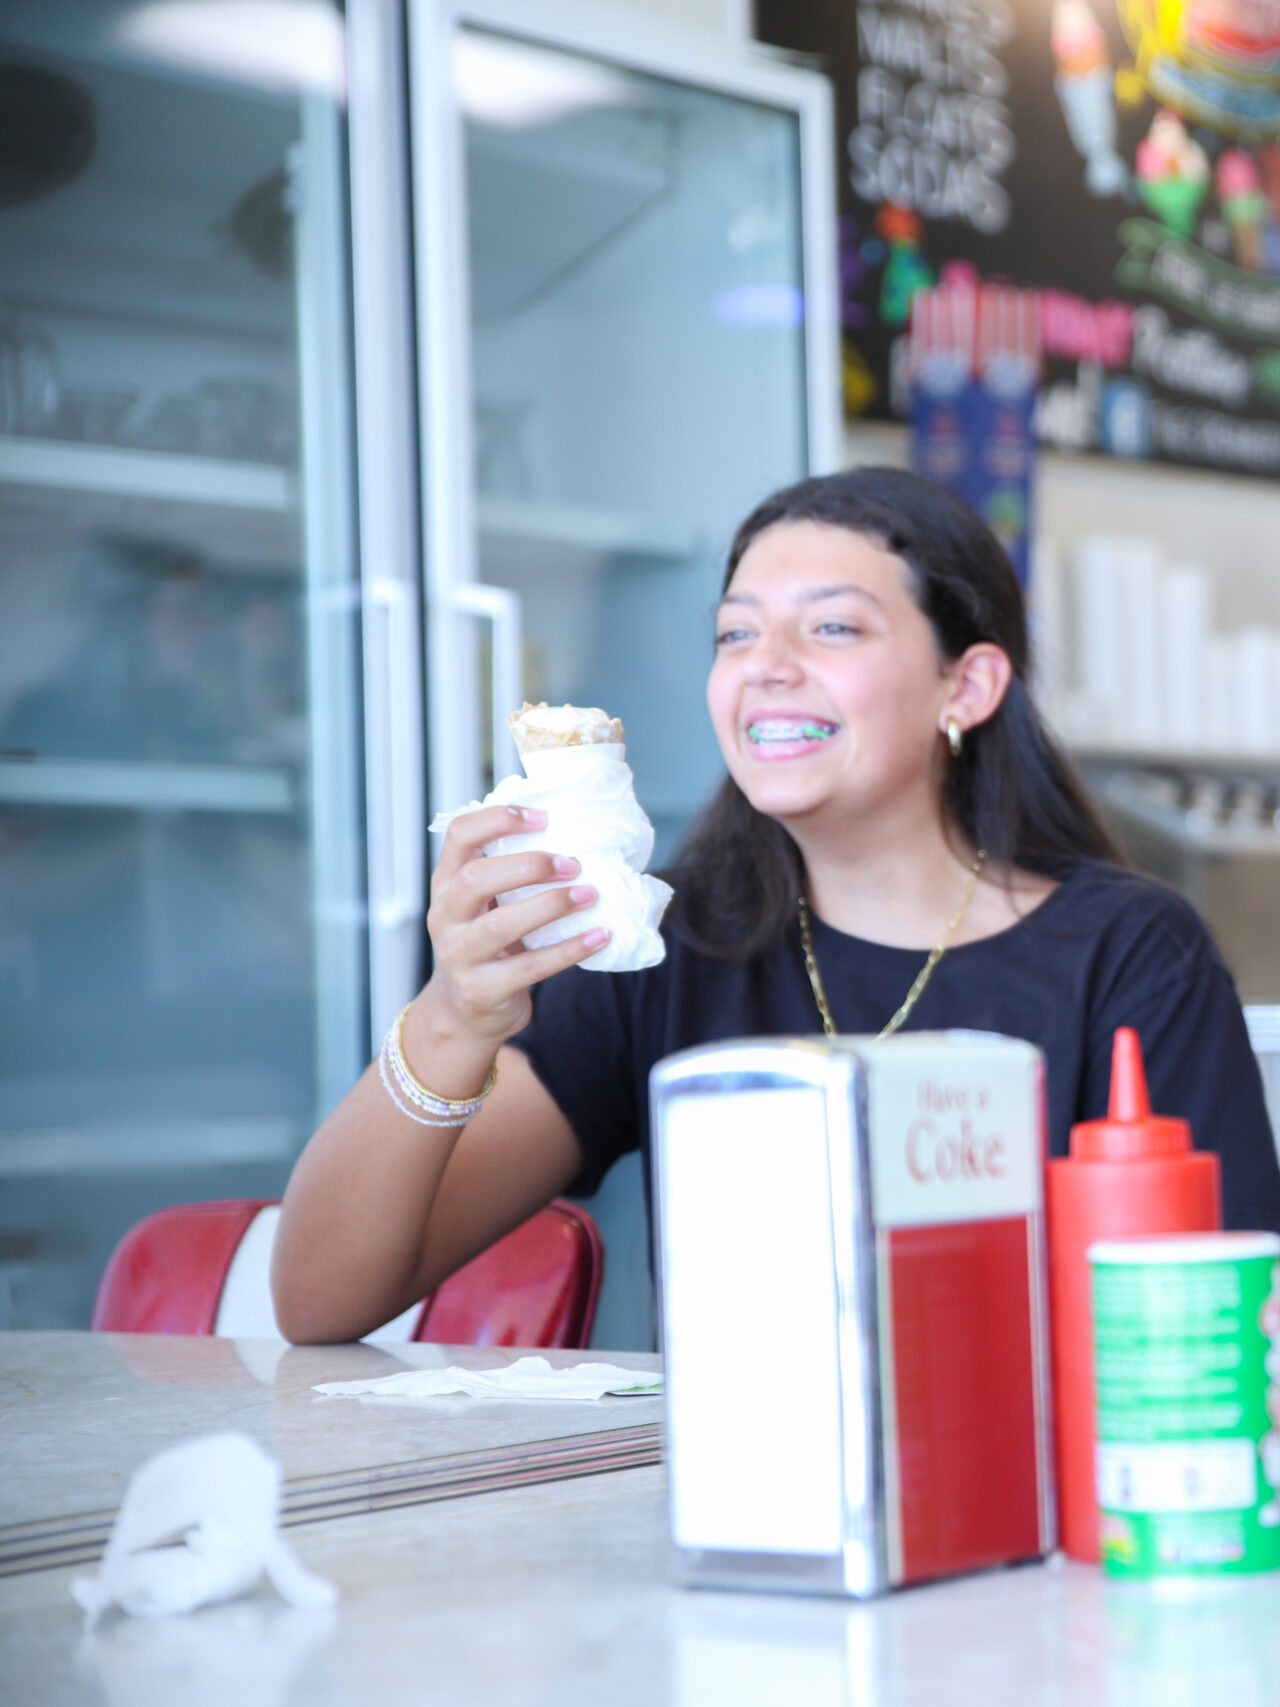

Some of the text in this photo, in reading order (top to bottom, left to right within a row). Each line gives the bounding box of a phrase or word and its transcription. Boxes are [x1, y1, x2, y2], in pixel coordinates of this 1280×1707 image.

[857, 2, 1007, 98] MALTS
[858, 65, 1015, 171] FLOATS
[848, 122, 1010, 233] SODAS
[917, 1078, 968, 1112] Have
[904, 1118, 1006, 1184] Coke
